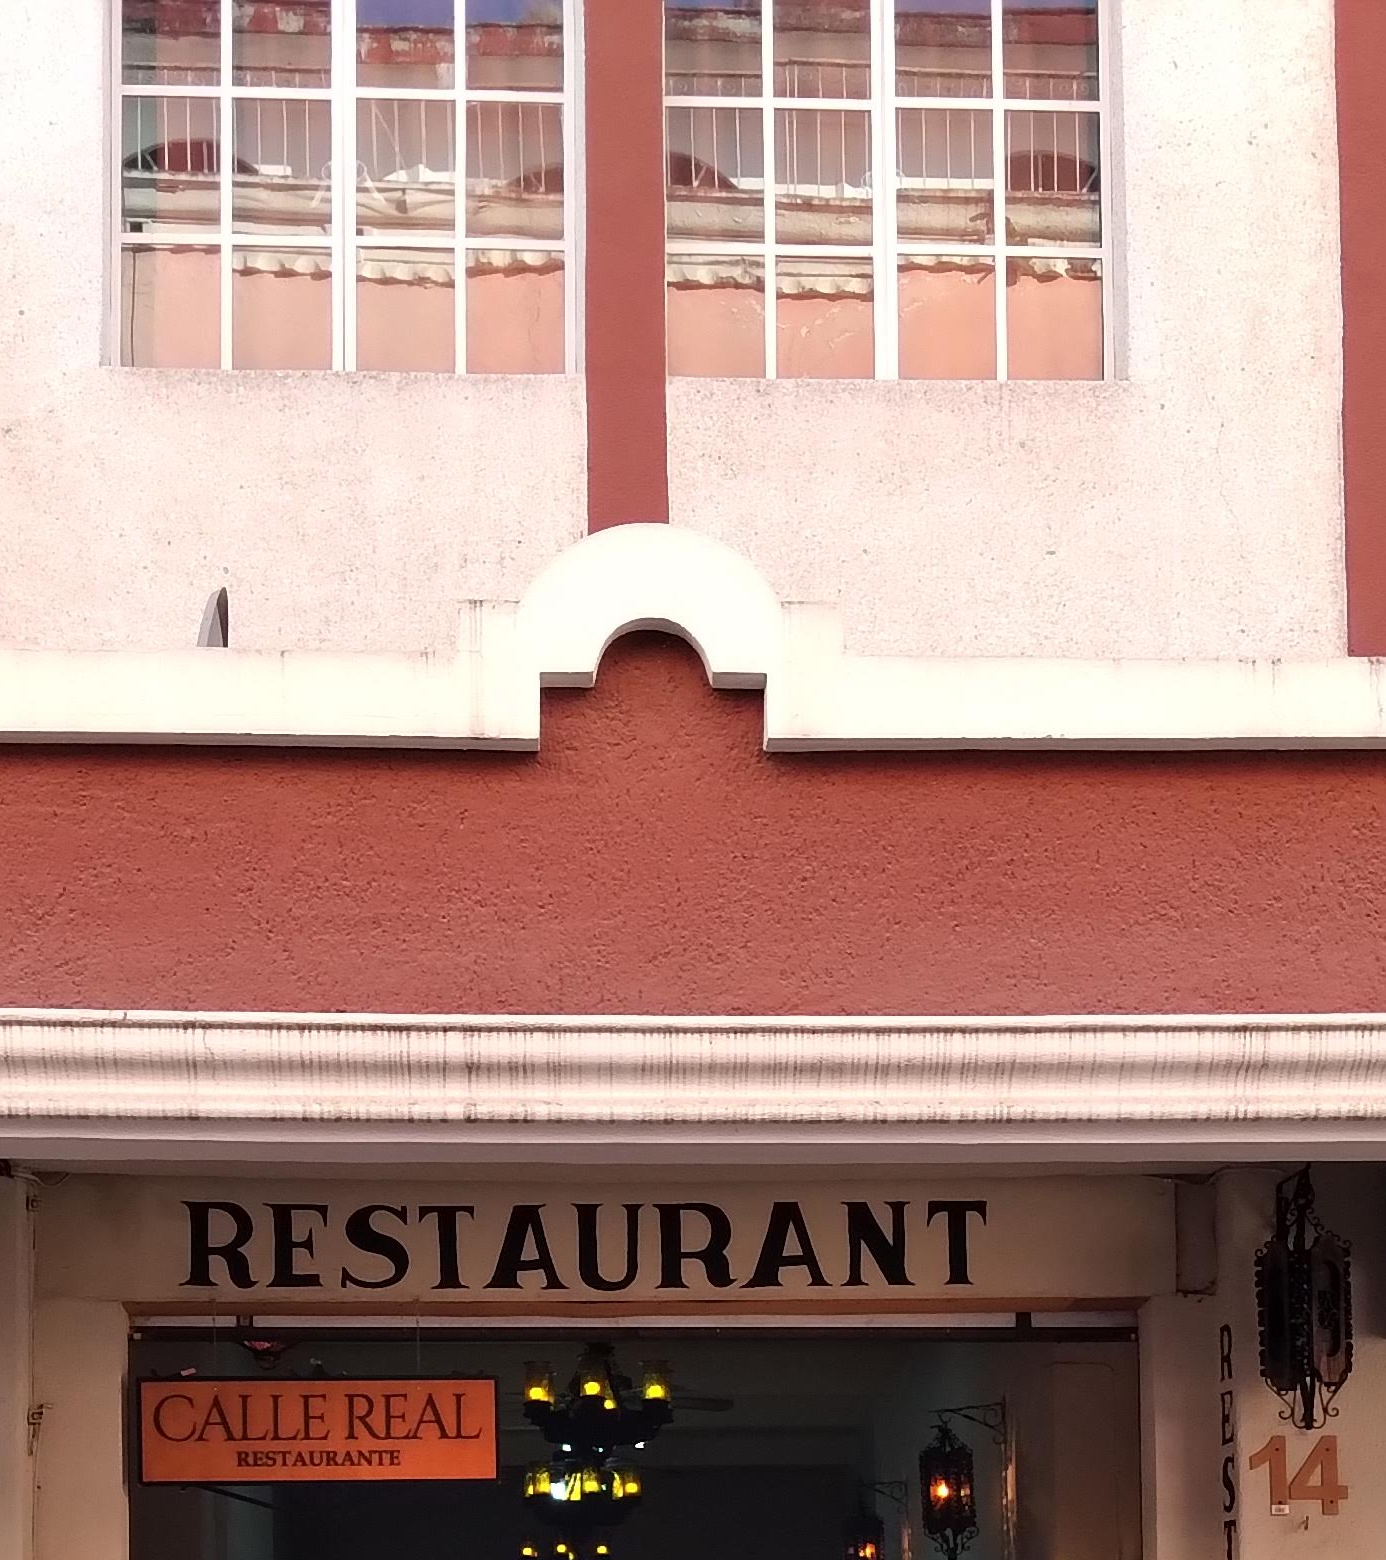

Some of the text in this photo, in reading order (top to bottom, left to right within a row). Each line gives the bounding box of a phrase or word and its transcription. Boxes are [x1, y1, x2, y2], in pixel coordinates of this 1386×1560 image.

[178, 1200, 988, 1291] RESTAURANT
[152, 1392, 482, 1443] CALLE REAL
[236, 1450, 401, 1468] RESTAURANTE
[1250, 1434, 1348, 1516] 14
